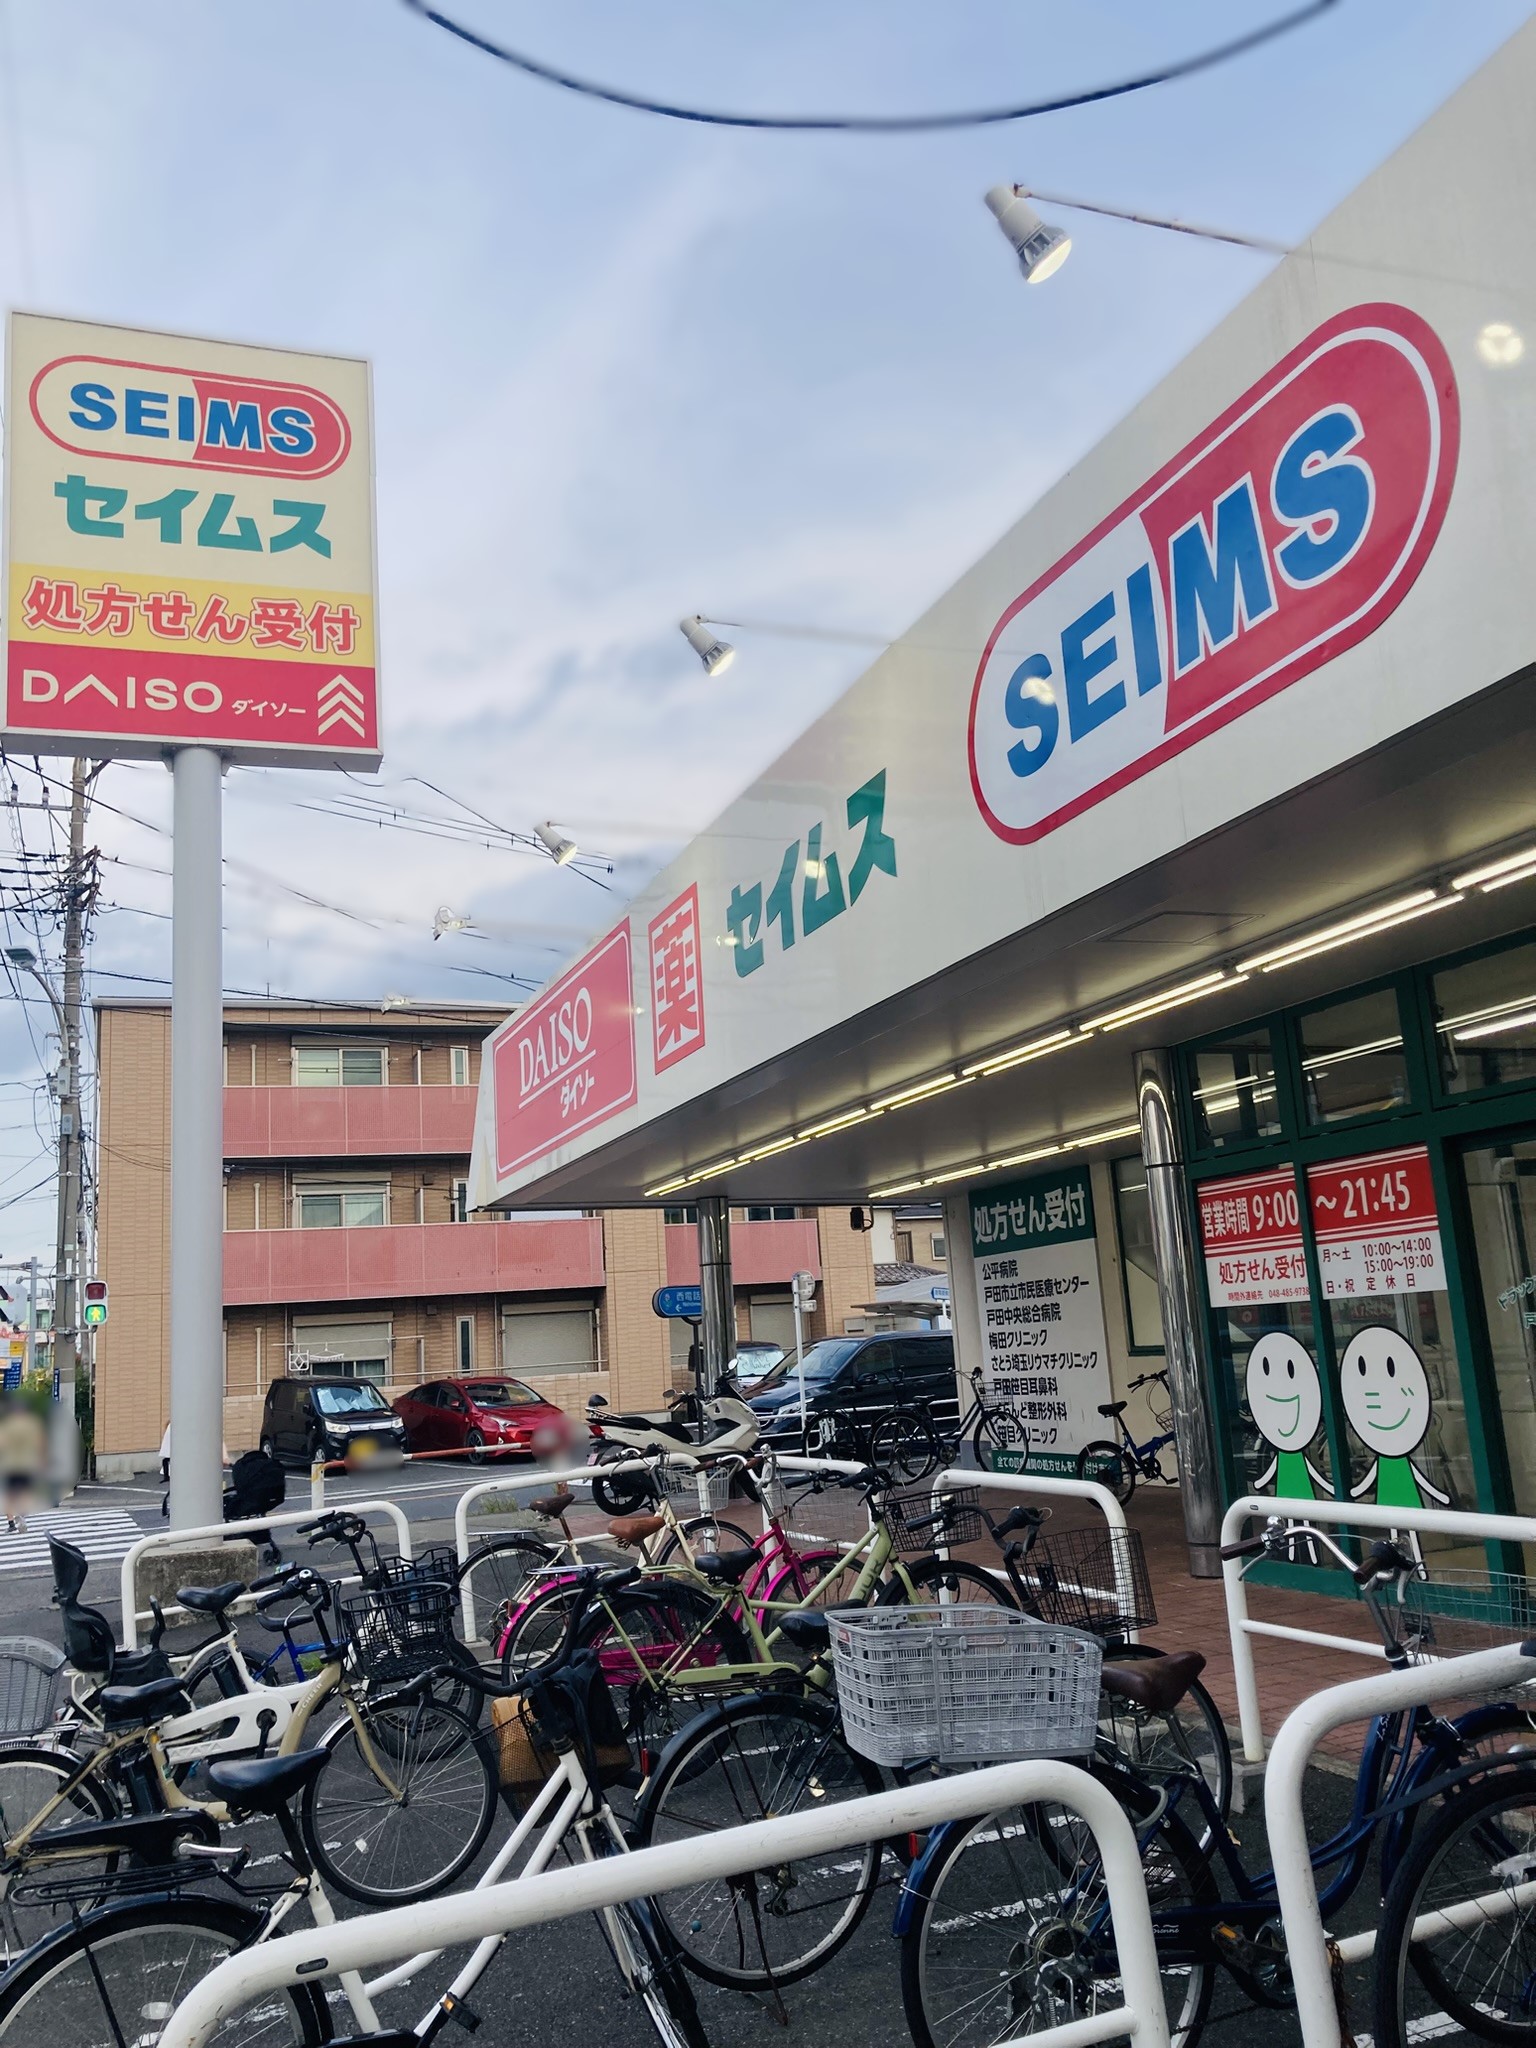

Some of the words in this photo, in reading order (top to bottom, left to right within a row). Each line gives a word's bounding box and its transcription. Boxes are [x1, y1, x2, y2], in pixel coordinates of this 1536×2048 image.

[68, 382, 317, 456] SEIMS
[54, 474, 332, 559] セイムス
[1005, 403, 1376, 778] SEIMS
[22, 576, 361, 655] 処方せん受付
[21, 669, 223, 714] DAISO
[231, 699, 306, 717] ダイソー
[727, 768, 897, 978] セイムス
[654, 909, 698, 1054] 薬
[519, 987, 592, 1097] DAISO
[561, 1069, 594, 1118] ダイソー
[974, 1183, 1086, 1245] 処方せん受付
[1201, 1197, 1250, 1238] 営業時間
[1252, 1189, 1299, 1231] 9:00
[982, 1259, 1018, 1281] 公平病院
[984, 1276, 1089, 1303] 戸田市立市民医療センター
[1219, 1253, 1305, 1285] 処方せん受付
[986, 1302, 1062, 1326] 戸田中央総合病院
[989, 1329, 1047, 1350] 梅田クリニック
[991, 1351, 1097, 1372] さとう埼玉リウマチクリニック
